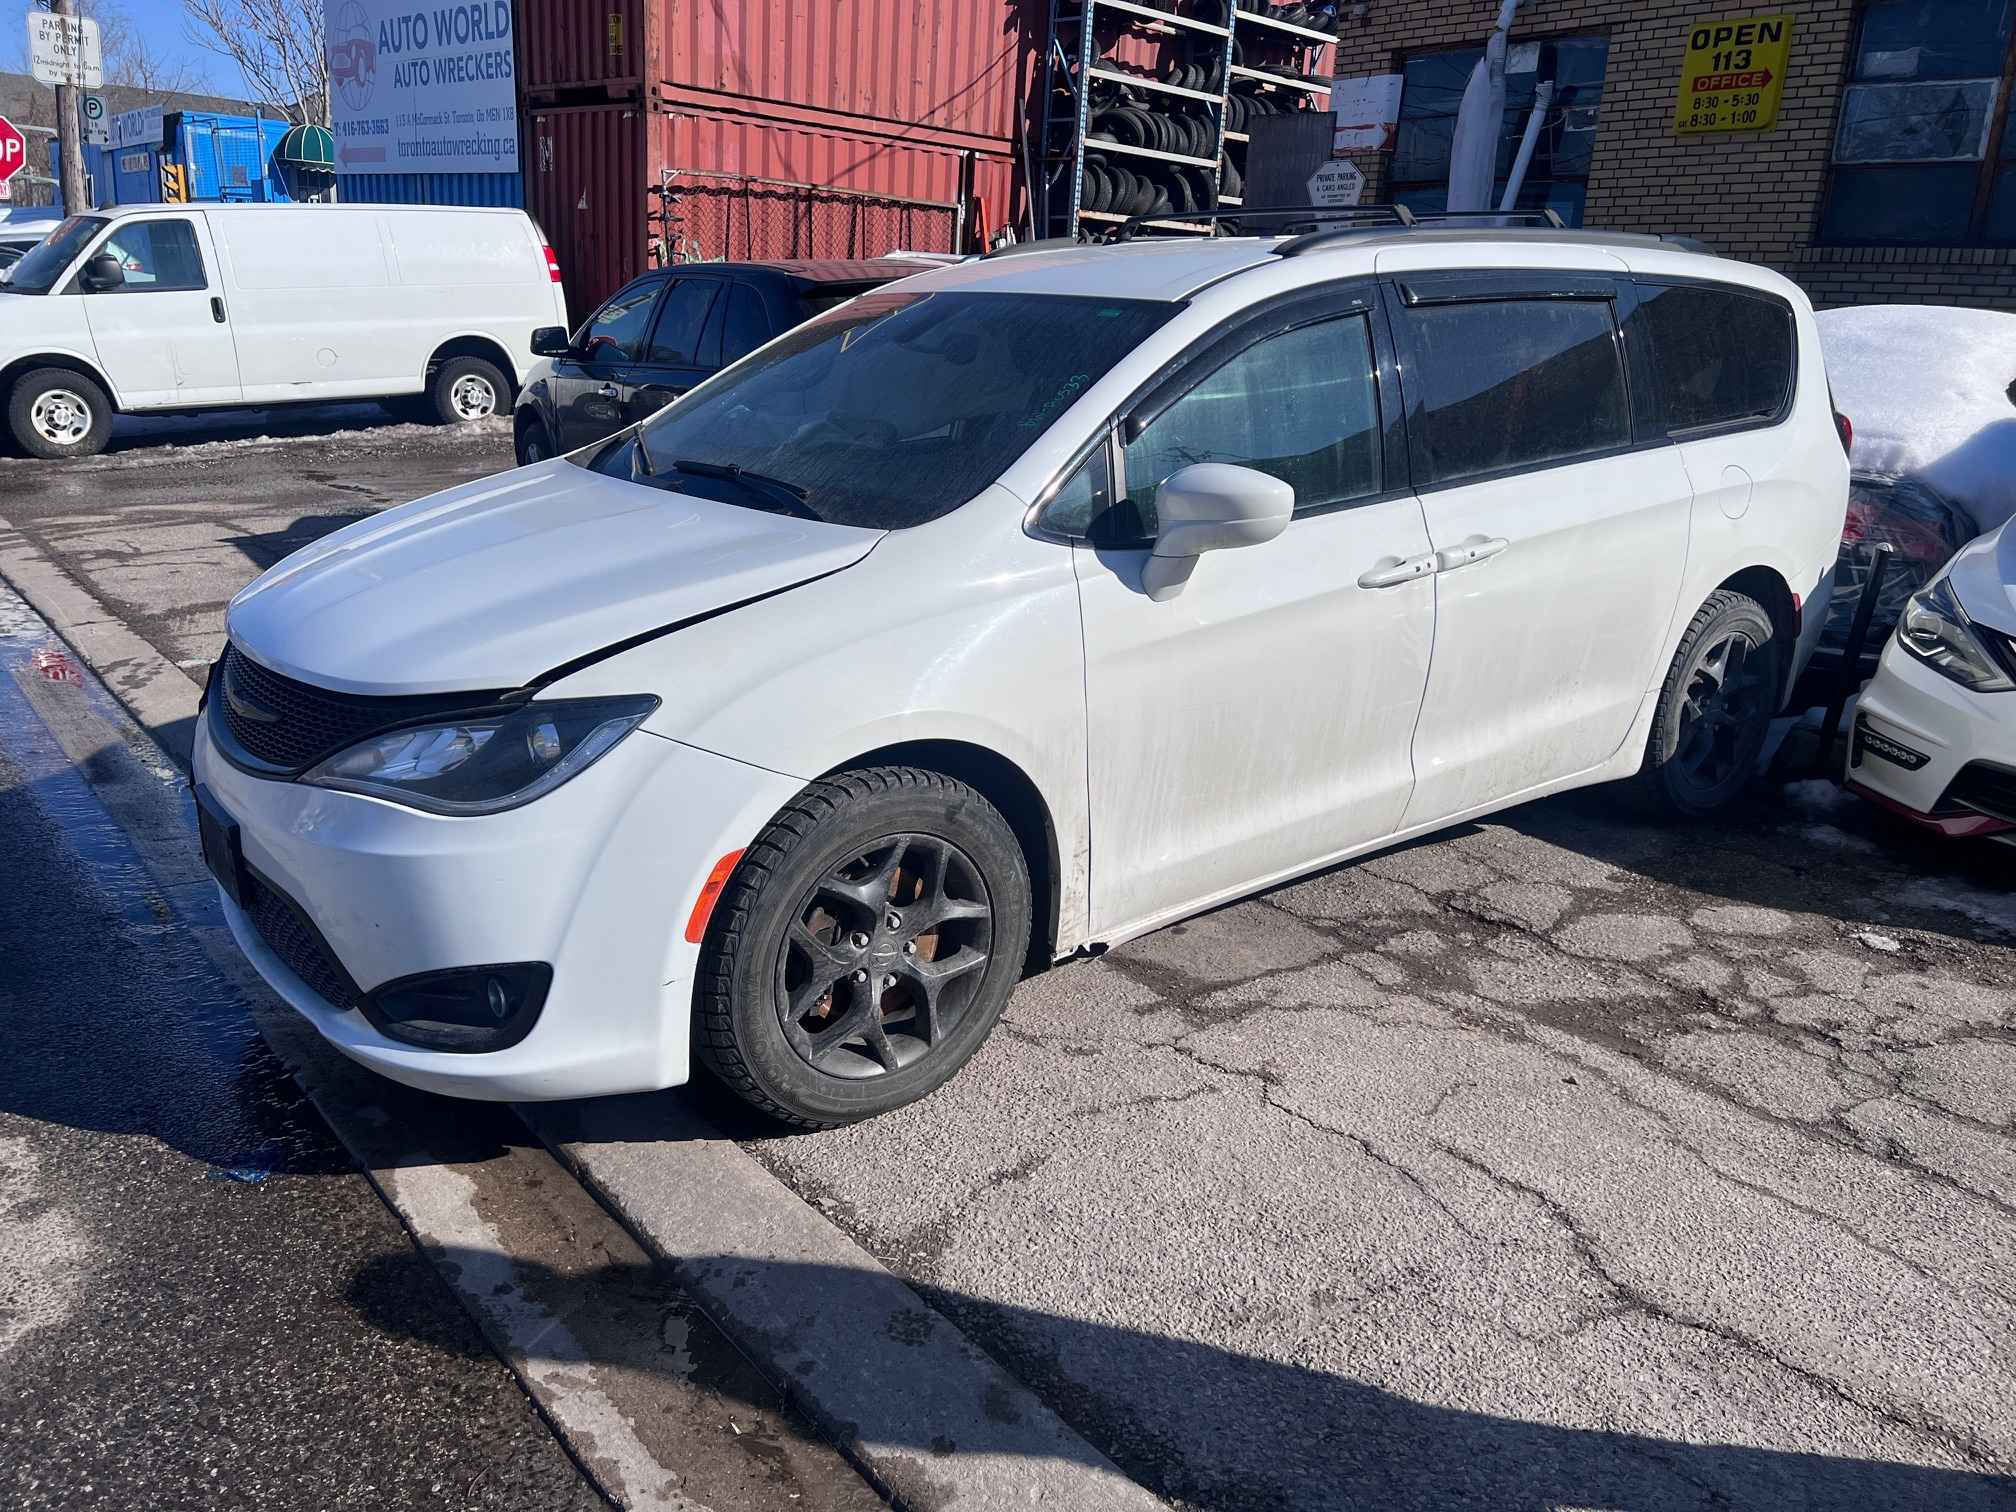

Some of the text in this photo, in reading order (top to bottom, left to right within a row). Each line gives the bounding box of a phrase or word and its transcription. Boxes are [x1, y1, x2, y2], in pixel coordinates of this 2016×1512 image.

[39, 30, 50, 41] BY
[378, 0, 511, 55] AUTO WORLD
[1691, 21, 1783, 50] OPEN
[53, 44, 76, 56] ONLY
[394, 50, 512, 88] AUTO WRECKERS
[1712, 48, 1752, 72] 113
[1697, 73, 1764, 90] OFFICE
[88, 102, 98, 114] P
[1693, 96, 1719, 110] 8:30
[1731, 92, 1760, 107] 5:30
[1689, 113, 1716, 127] 8:30
[1731, 110, 1757, 124] 1:00
[397, 131, 515, 160] torontoautowrecking.ca
